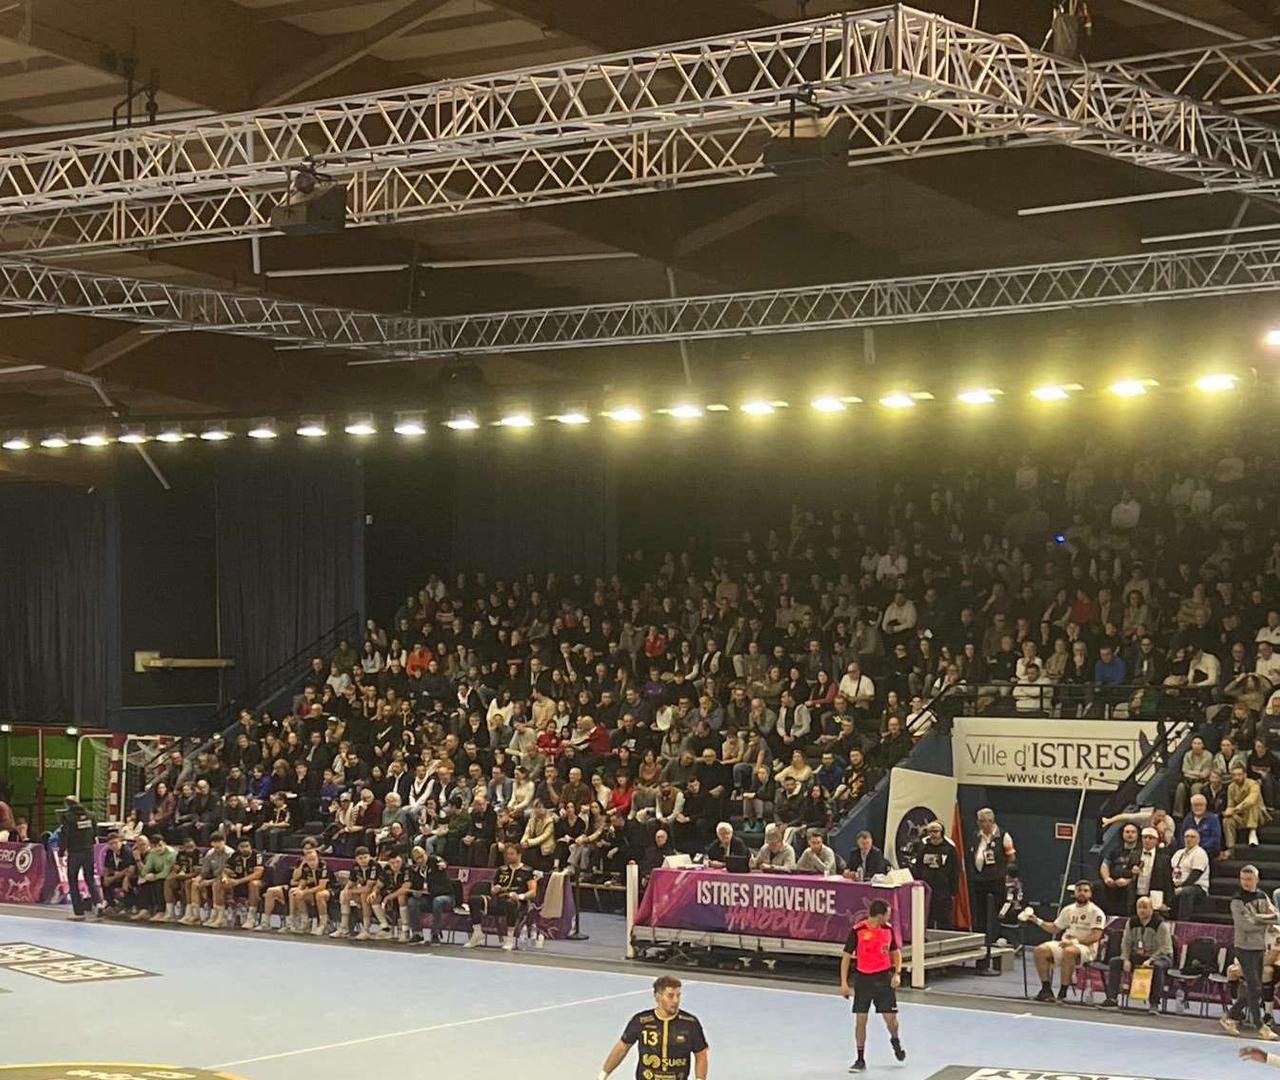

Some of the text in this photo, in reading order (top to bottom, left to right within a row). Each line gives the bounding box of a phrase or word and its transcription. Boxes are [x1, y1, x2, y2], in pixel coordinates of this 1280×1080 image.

[966, 742, 1131, 771] Ville d'ISTRES
[696, 879, 836, 915] ISTRES PROVENCE
[641, 1030, 659, 1046] 13
